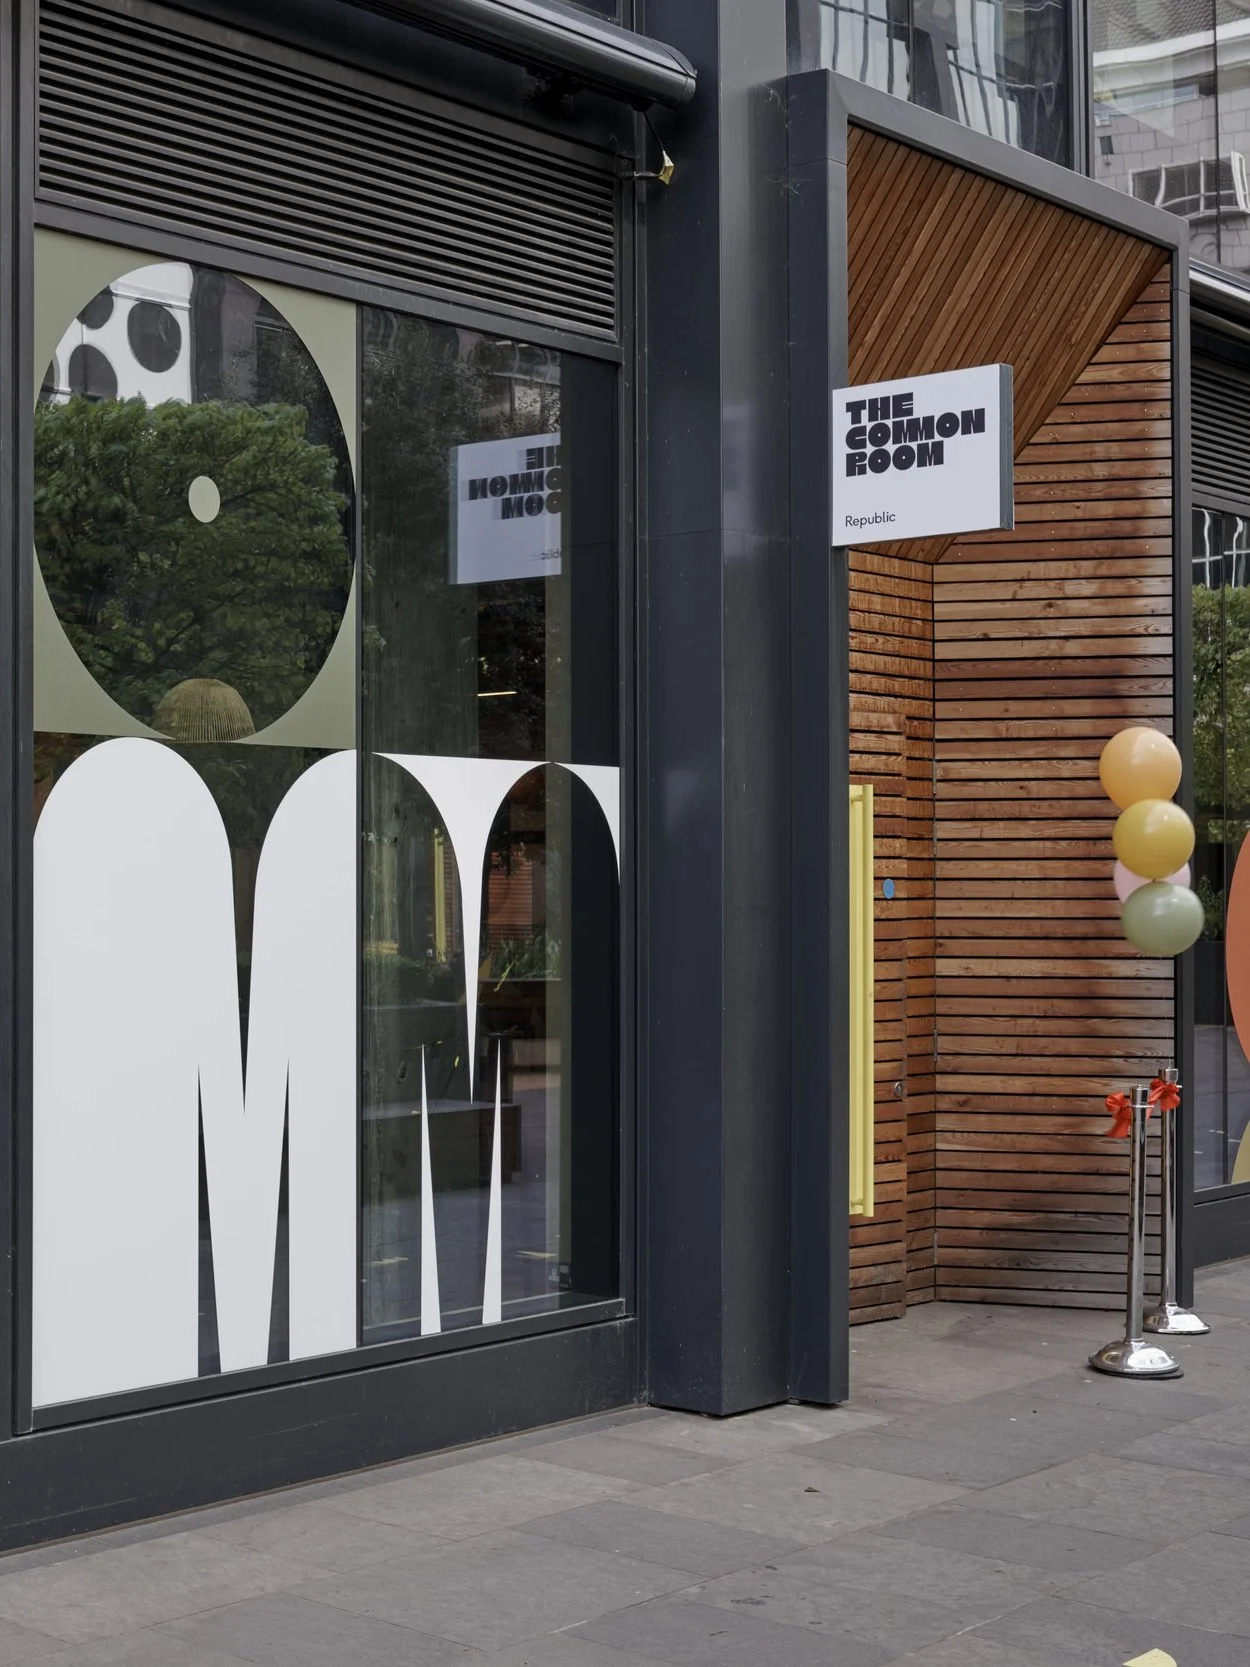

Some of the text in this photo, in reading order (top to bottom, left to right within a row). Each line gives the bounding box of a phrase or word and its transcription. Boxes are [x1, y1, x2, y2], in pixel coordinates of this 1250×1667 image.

[845, 391, 914, 426] THE
[845, 407, 986, 451] COMMON
[845, 440, 945, 478] ROOM
[845, 511, 897, 529] Republic
